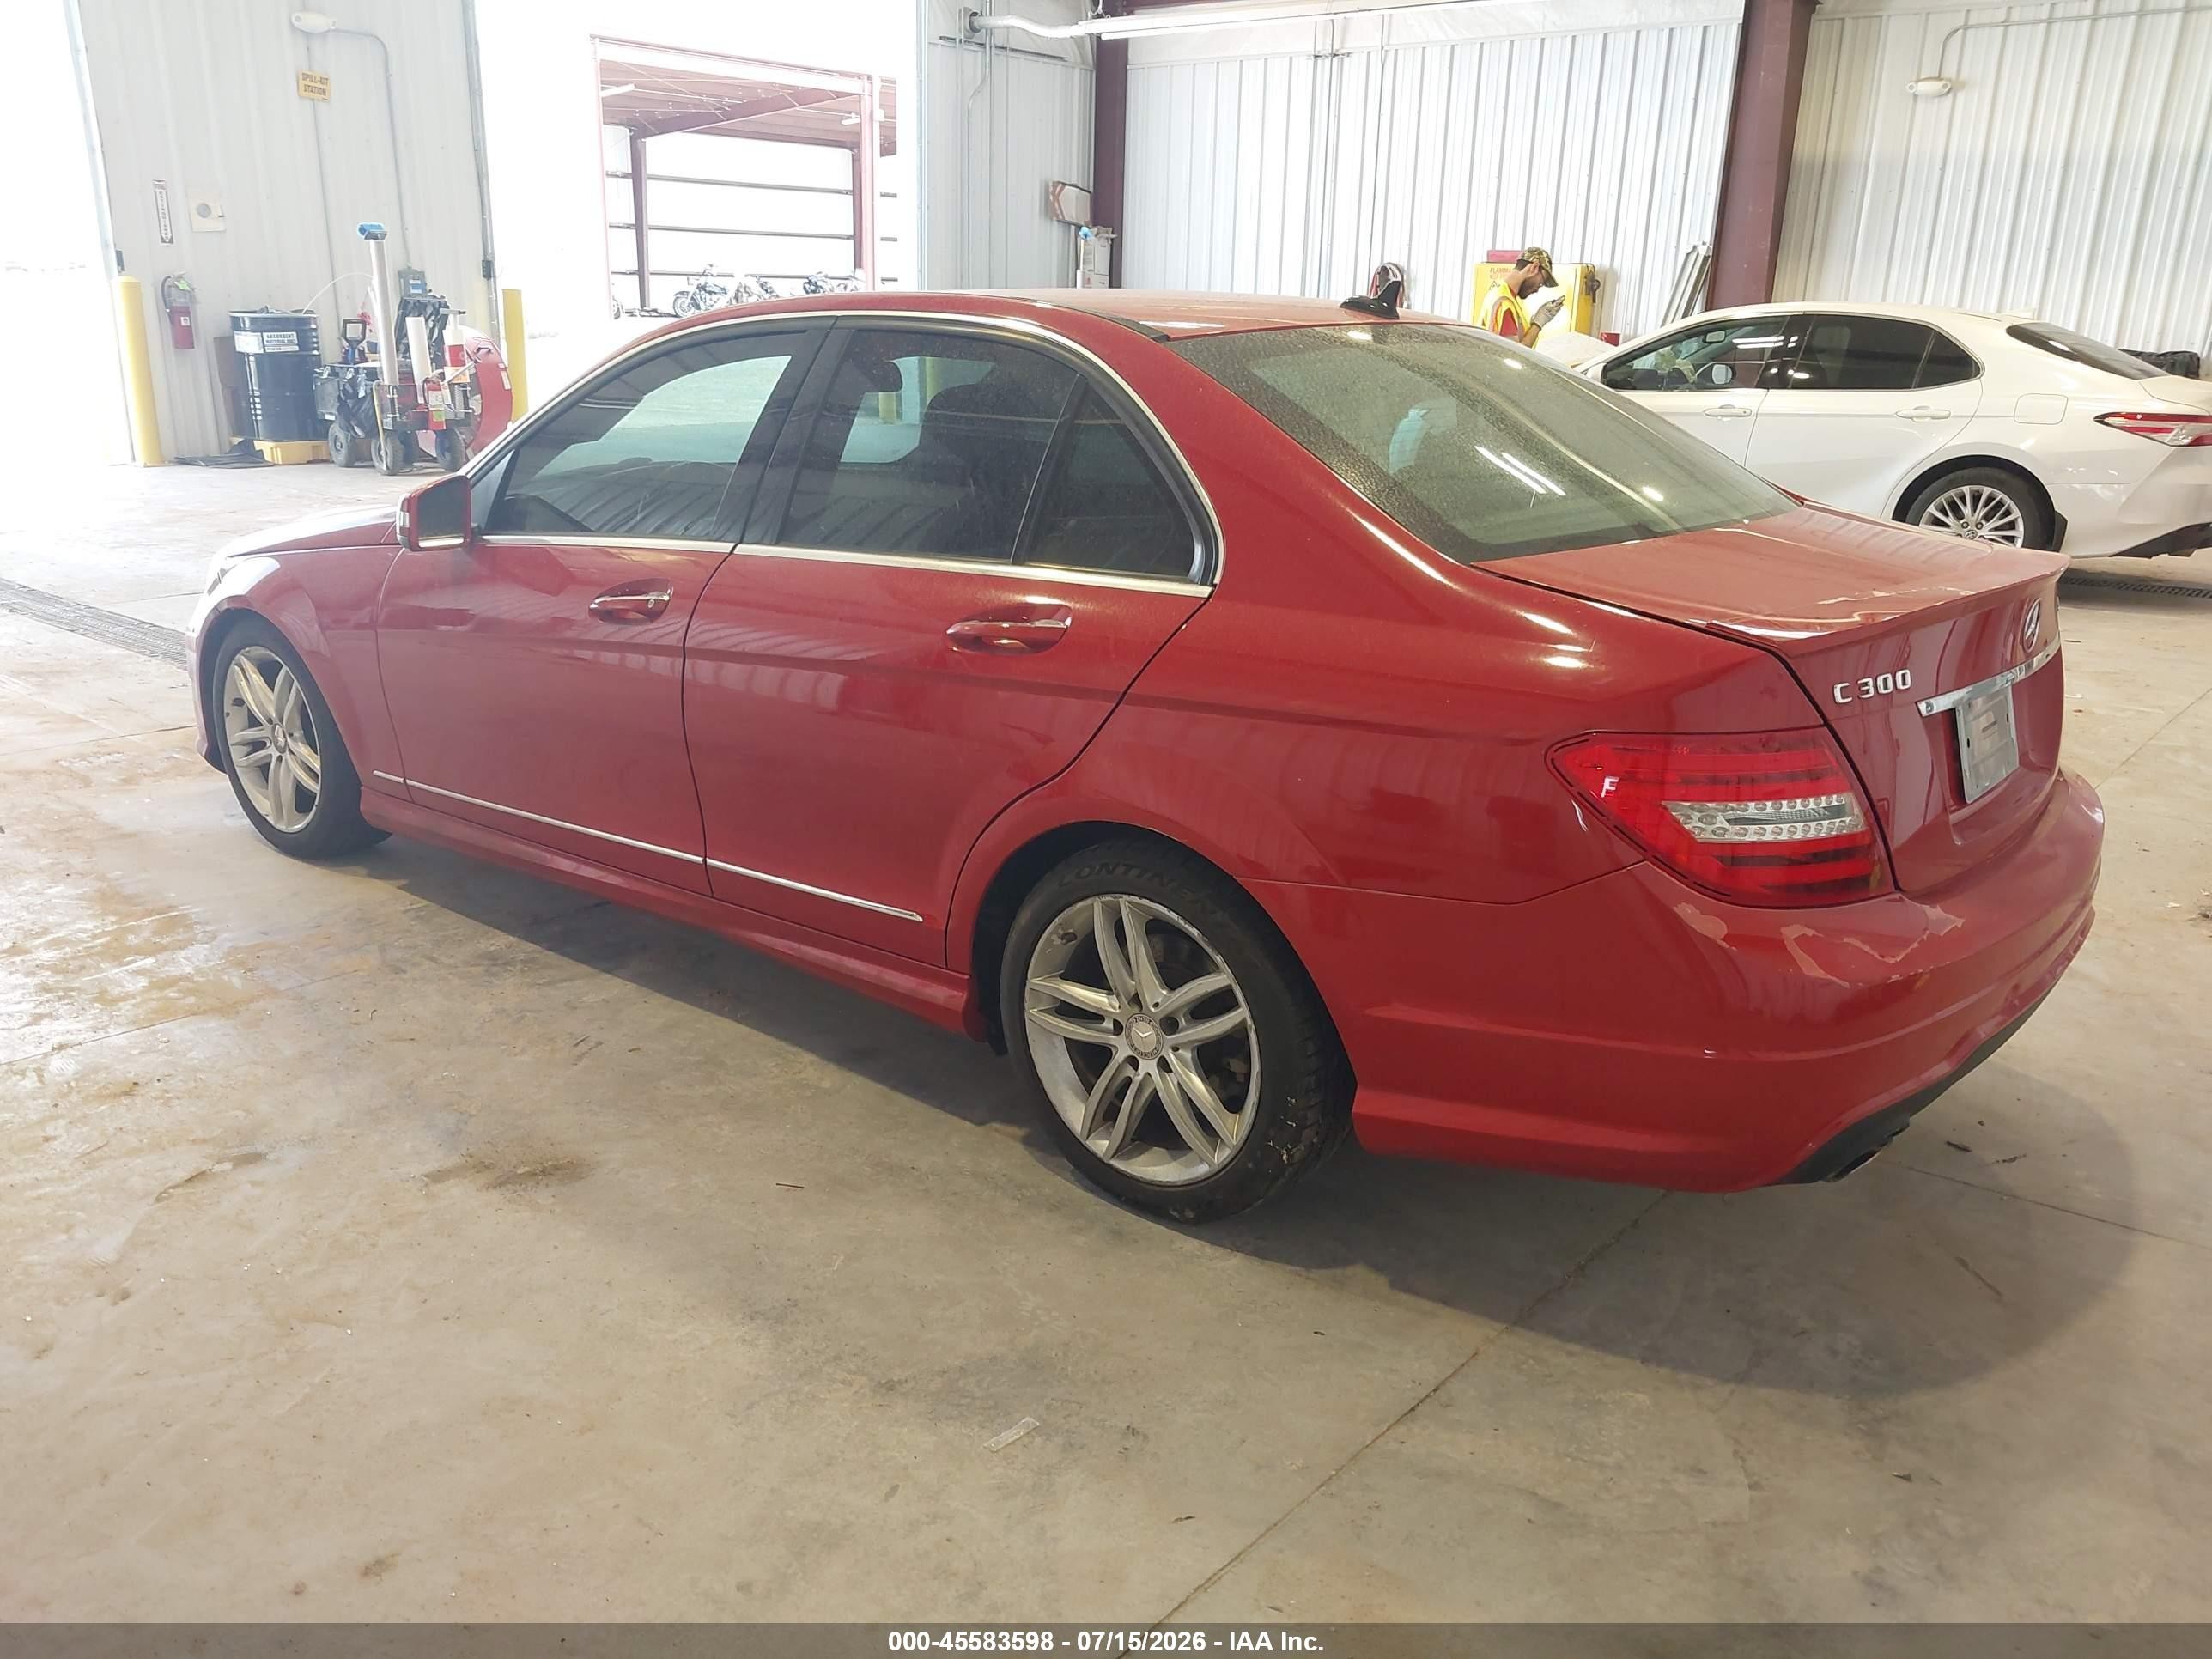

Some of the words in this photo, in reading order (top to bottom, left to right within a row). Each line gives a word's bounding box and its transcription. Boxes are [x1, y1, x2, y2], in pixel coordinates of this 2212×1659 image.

[304, 84, 326, 96] STATION
[1833, 682, 1853, 704] C
[1856, 669, 1911, 699] 300
